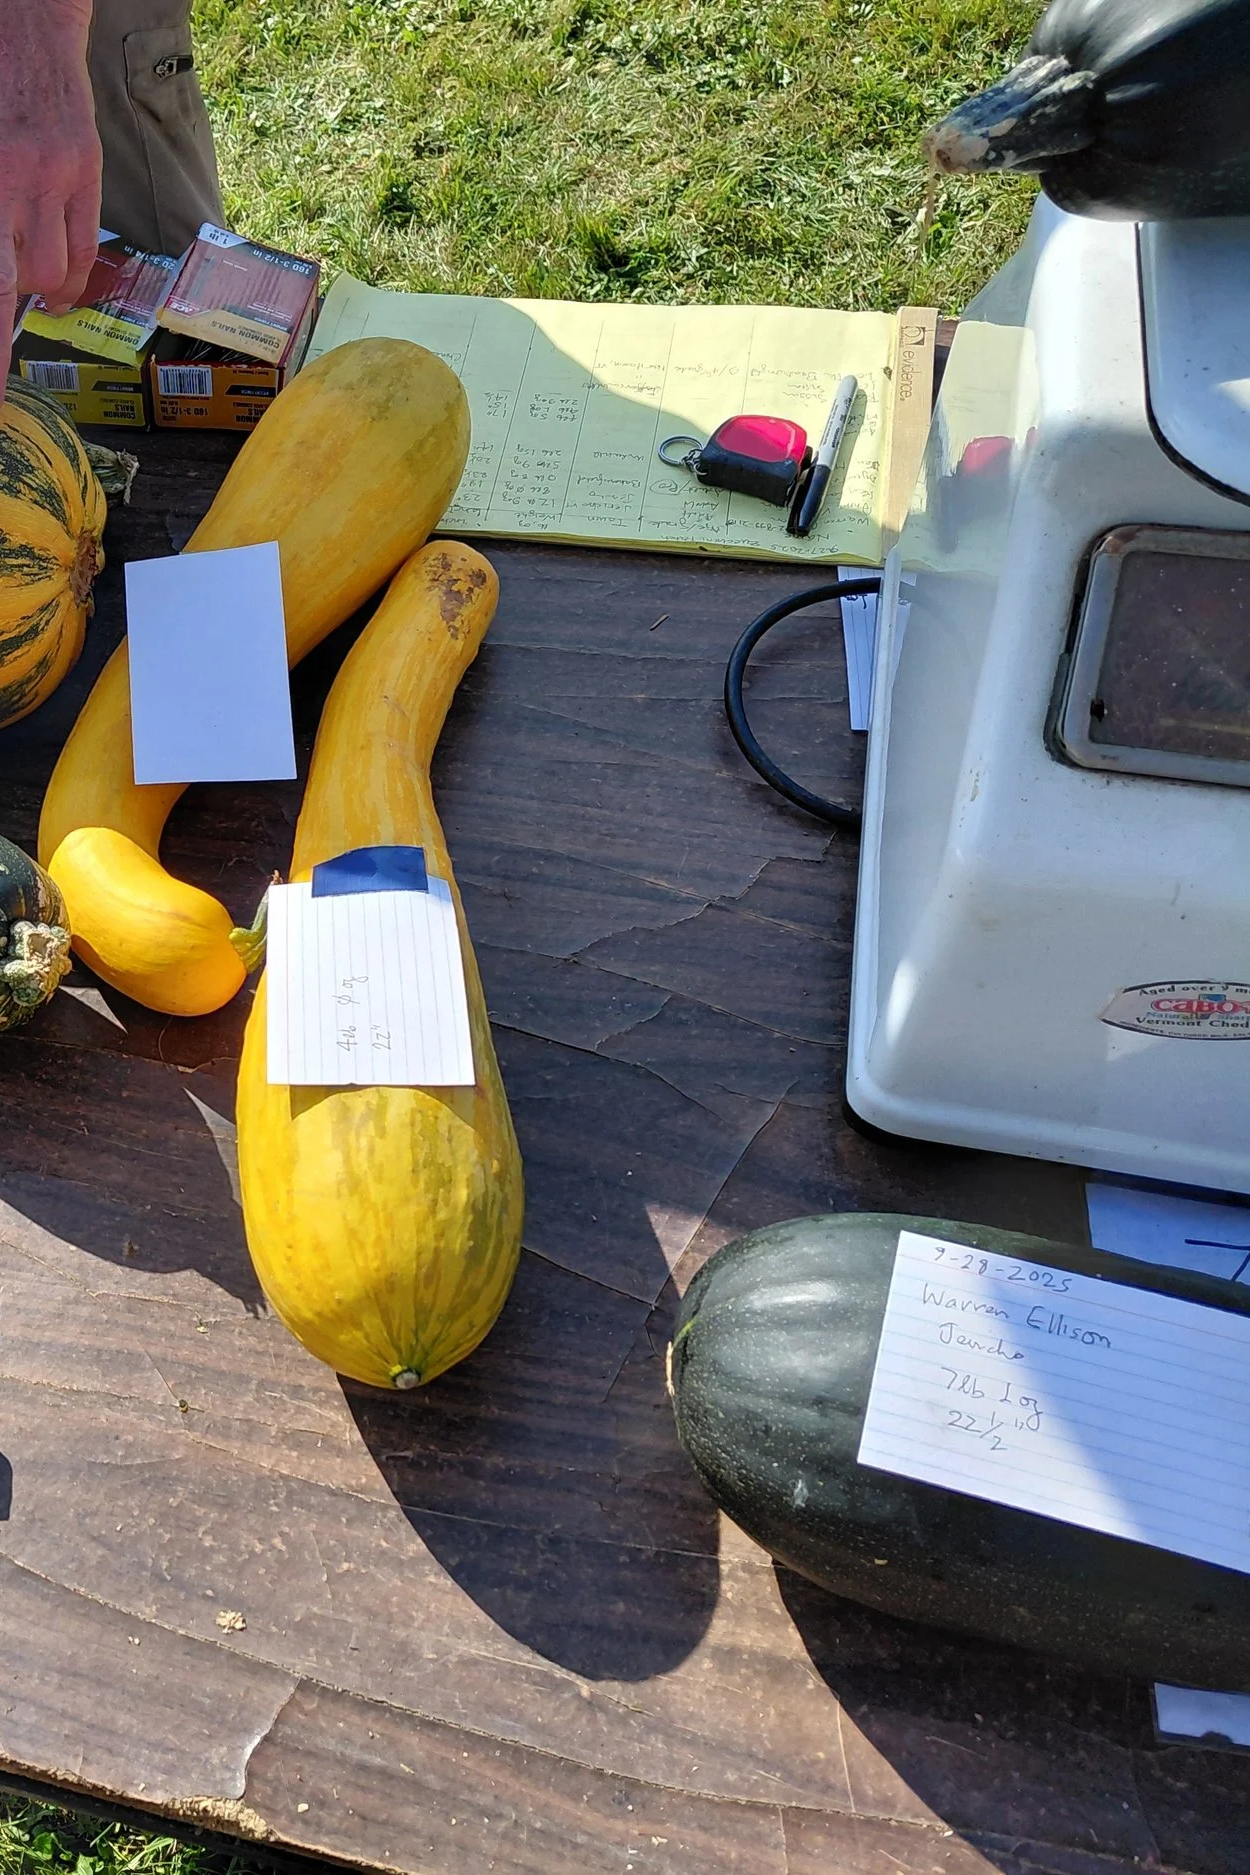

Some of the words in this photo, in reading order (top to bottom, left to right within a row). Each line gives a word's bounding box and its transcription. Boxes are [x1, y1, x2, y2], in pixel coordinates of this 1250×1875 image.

[169, 301, 193, 314] ACE
[76, 319, 102, 334] NAILS
[211, 320, 237, 334] NAILS
[103, 329, 140, 346] OMMON
[238, 329, 281, 349] COMMON
[1139, 985, 1175, 996] Aged
[1136, 1017, 1202, 1026] Vermont
[934, 1245, 1073, 1294] 9-28-2025
[921, 1281, 1010, 1320] Warren
[1026, 1304, 1113, 1350] Ellison
